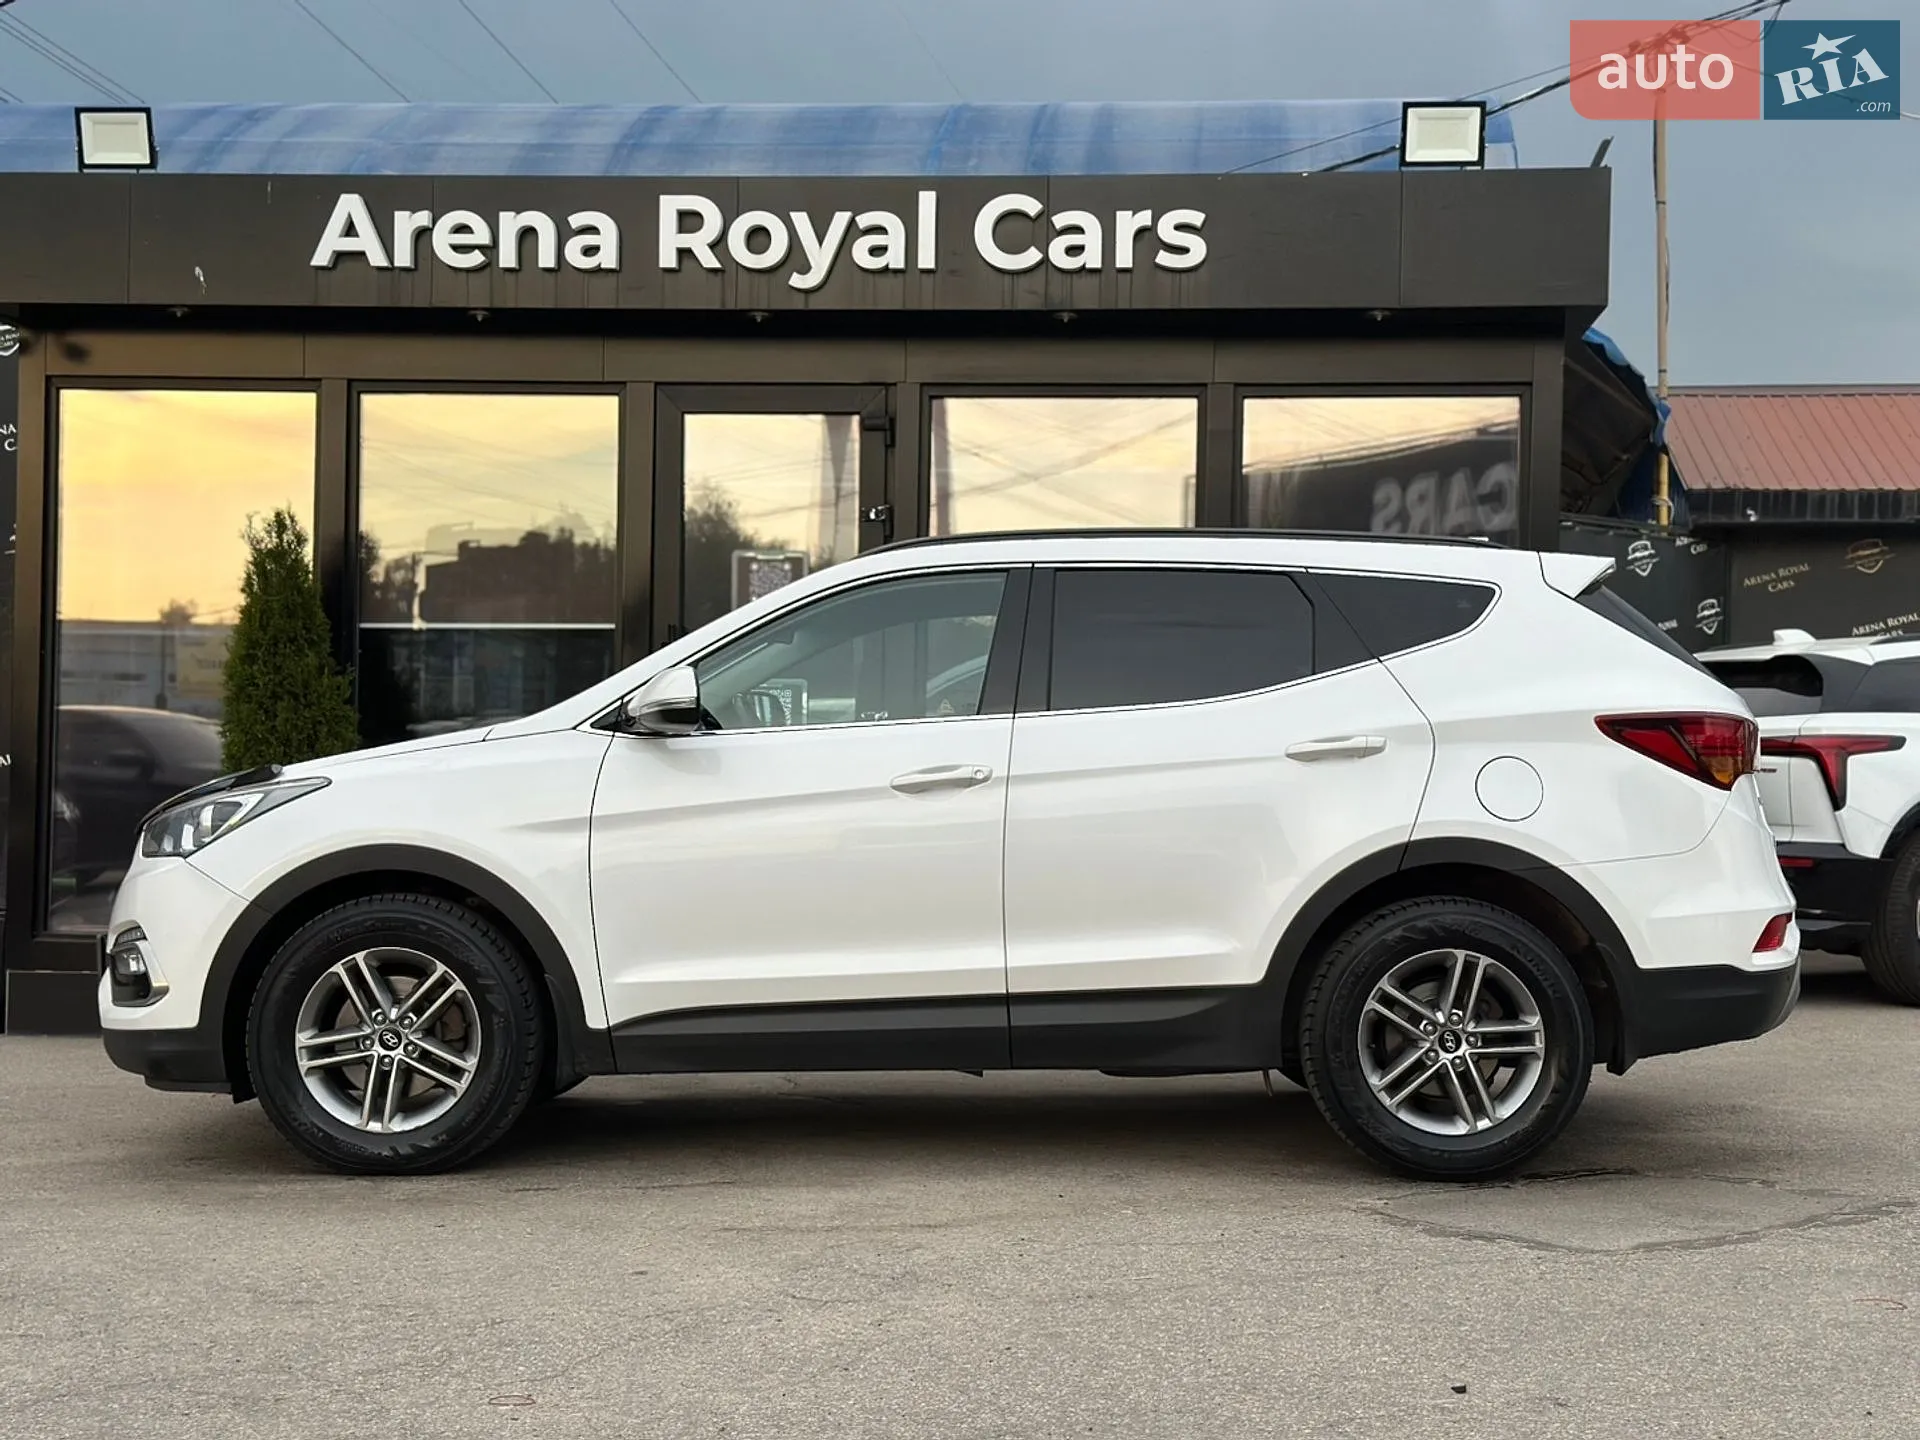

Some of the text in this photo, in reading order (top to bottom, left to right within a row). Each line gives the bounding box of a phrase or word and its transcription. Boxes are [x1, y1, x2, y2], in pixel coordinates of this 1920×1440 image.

[309, 190, 1208, 291] Arena Royal Cars
[1743, 562, 1810, 588] ARENA ROYAL
[1767, 580, 1795, 593] CARS
[1851, 612, 1920, 637] ARENA ROYAL
